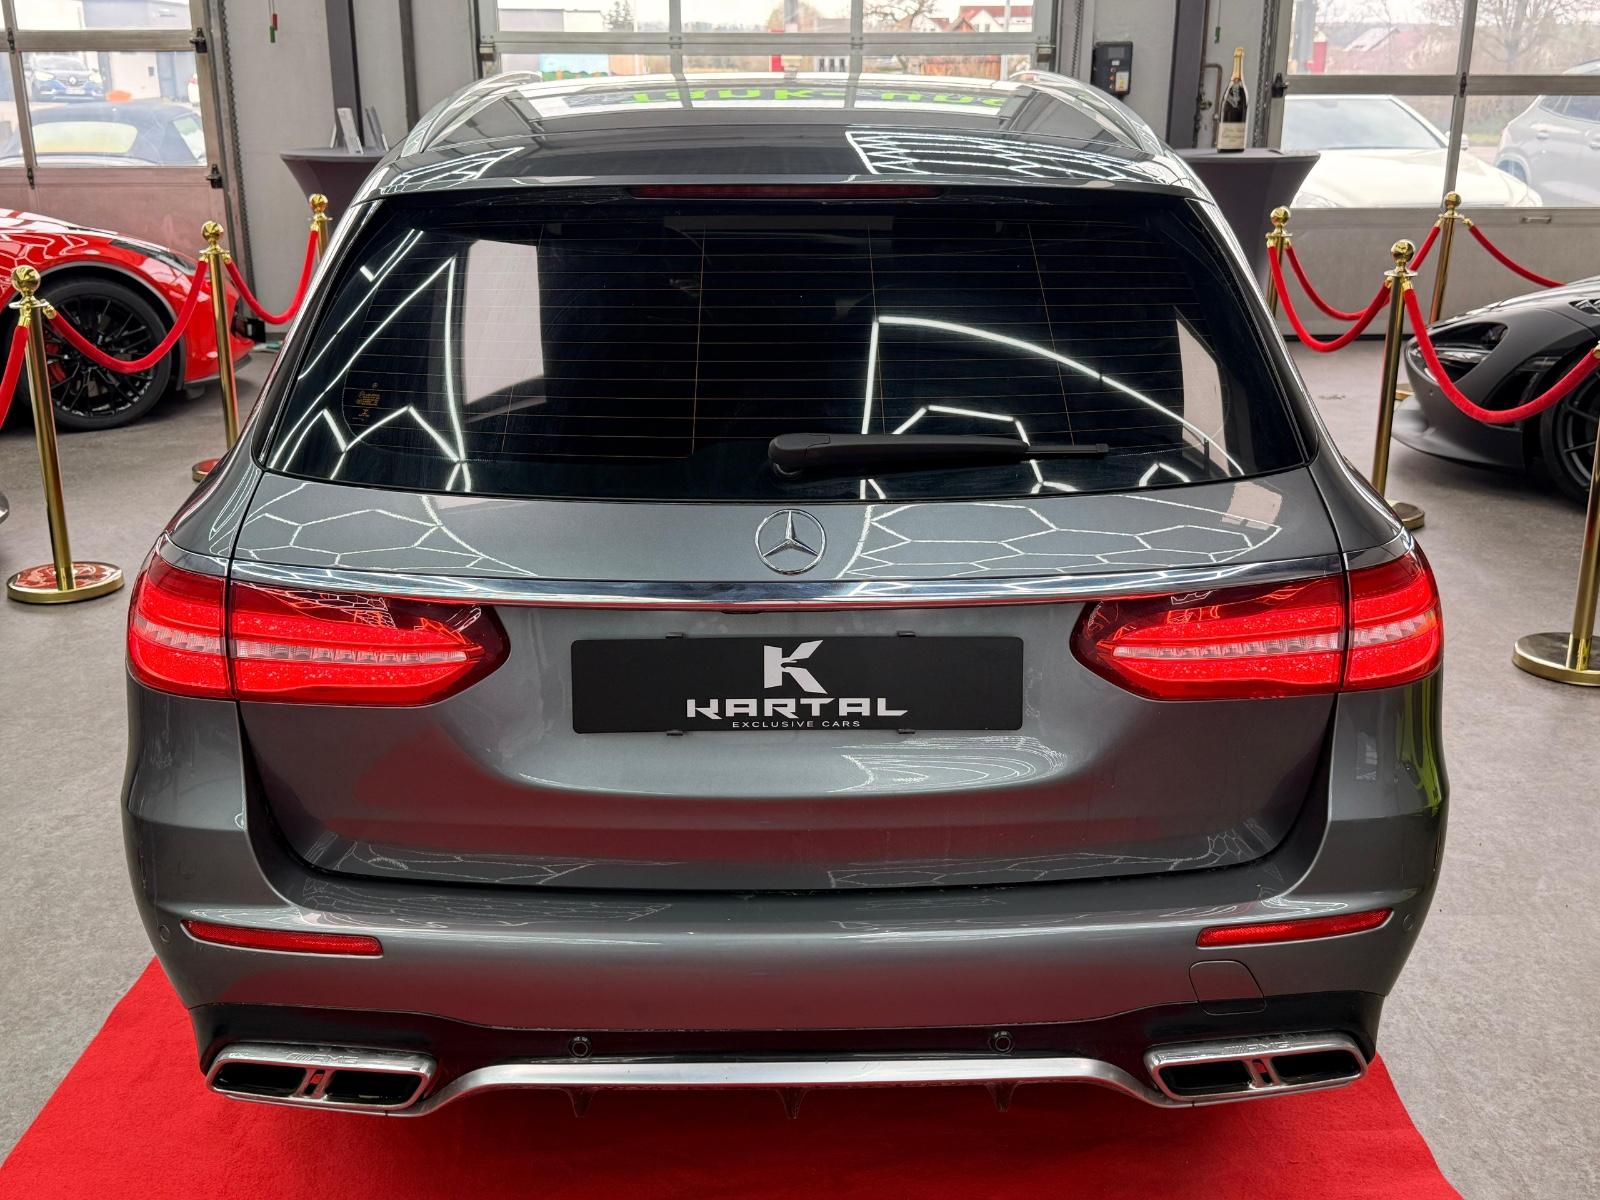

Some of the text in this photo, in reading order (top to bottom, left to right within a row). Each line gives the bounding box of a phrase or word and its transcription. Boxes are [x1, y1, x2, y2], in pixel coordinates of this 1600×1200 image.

[763, 639, 828, 694] K
[686, 697, 908, 720] KARTAL
[732, 720, 861, 728] EXCLUSIVE CARS
